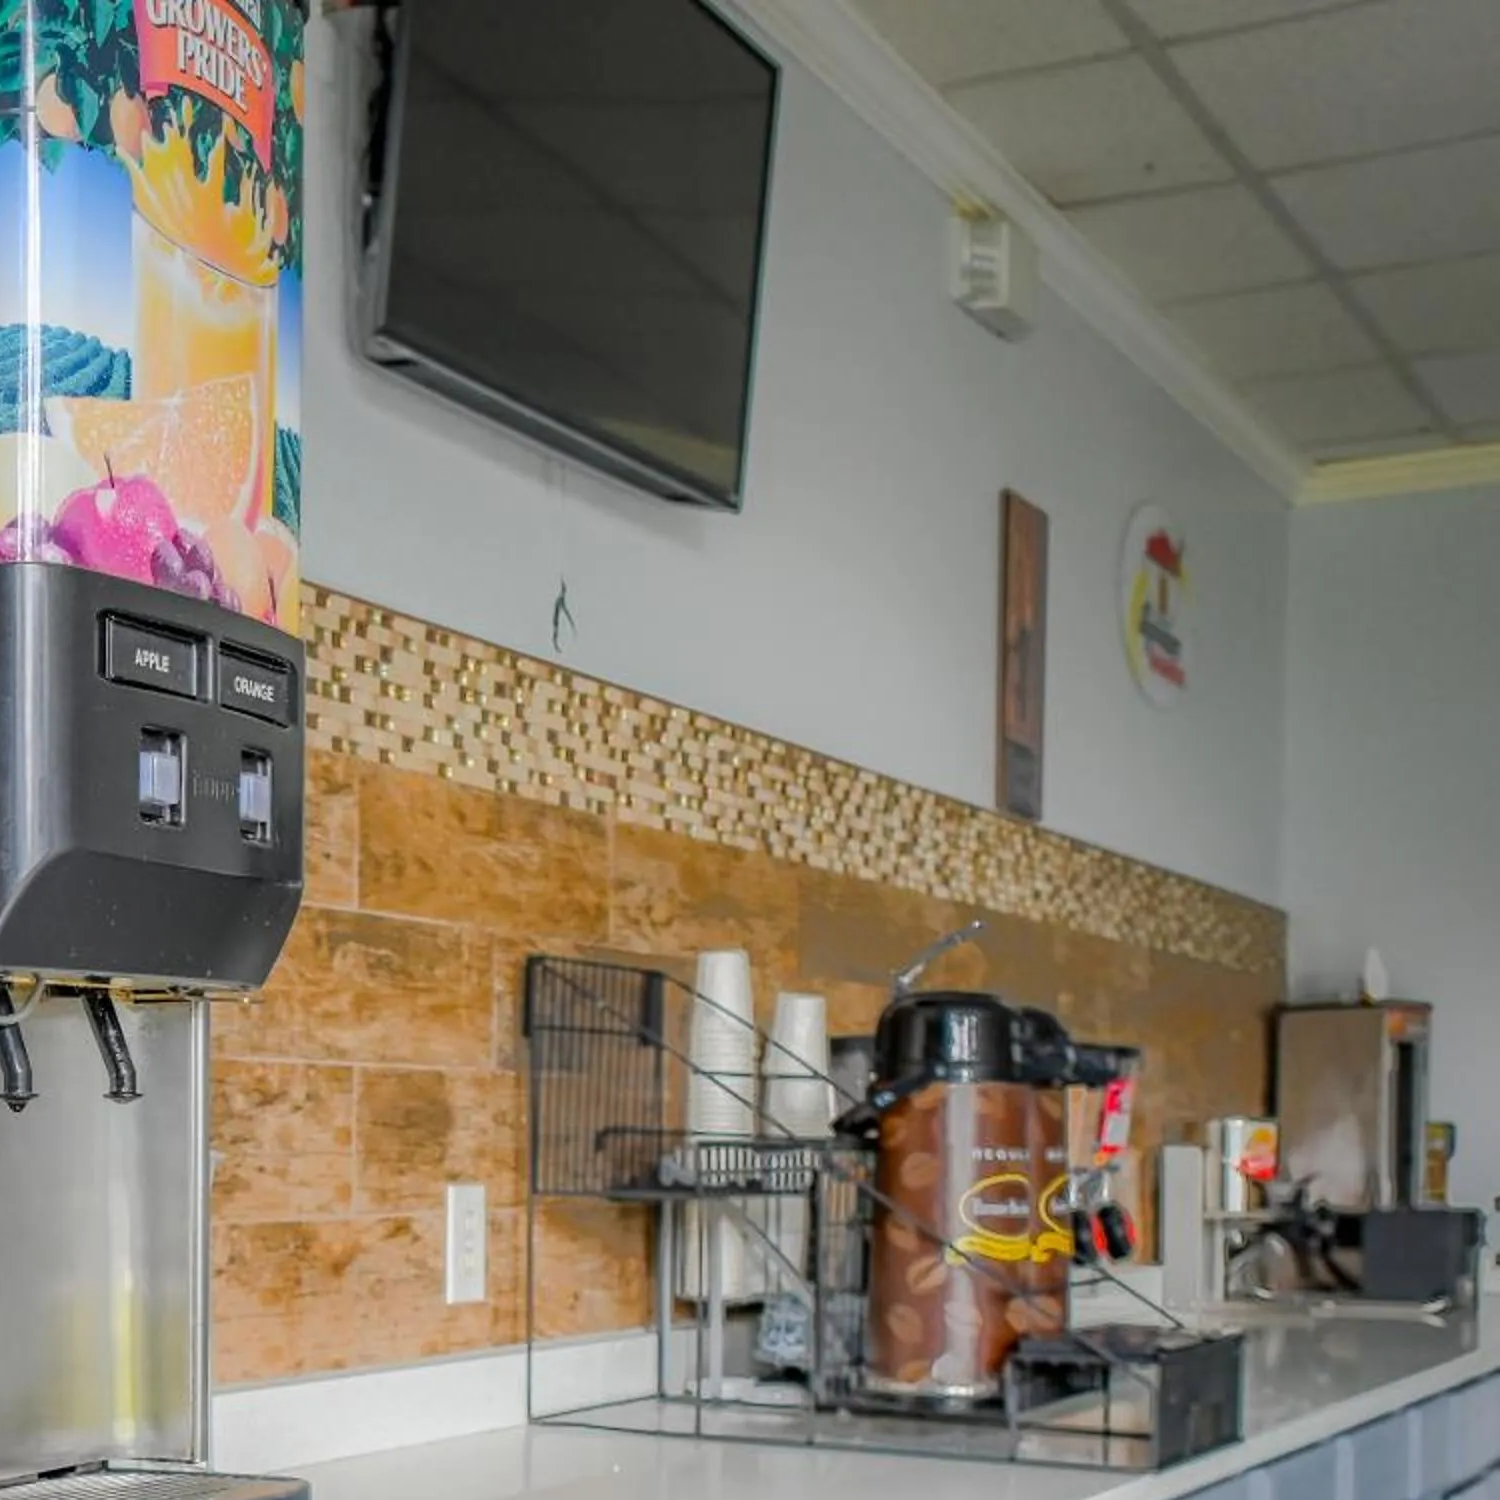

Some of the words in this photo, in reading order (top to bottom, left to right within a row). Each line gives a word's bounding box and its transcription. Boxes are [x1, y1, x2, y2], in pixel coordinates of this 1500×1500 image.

[177, 28, 248, 113] PRIDE
[135, 649, 170, 672] APPLE
[234, 676, 274, 702] ORANGE
